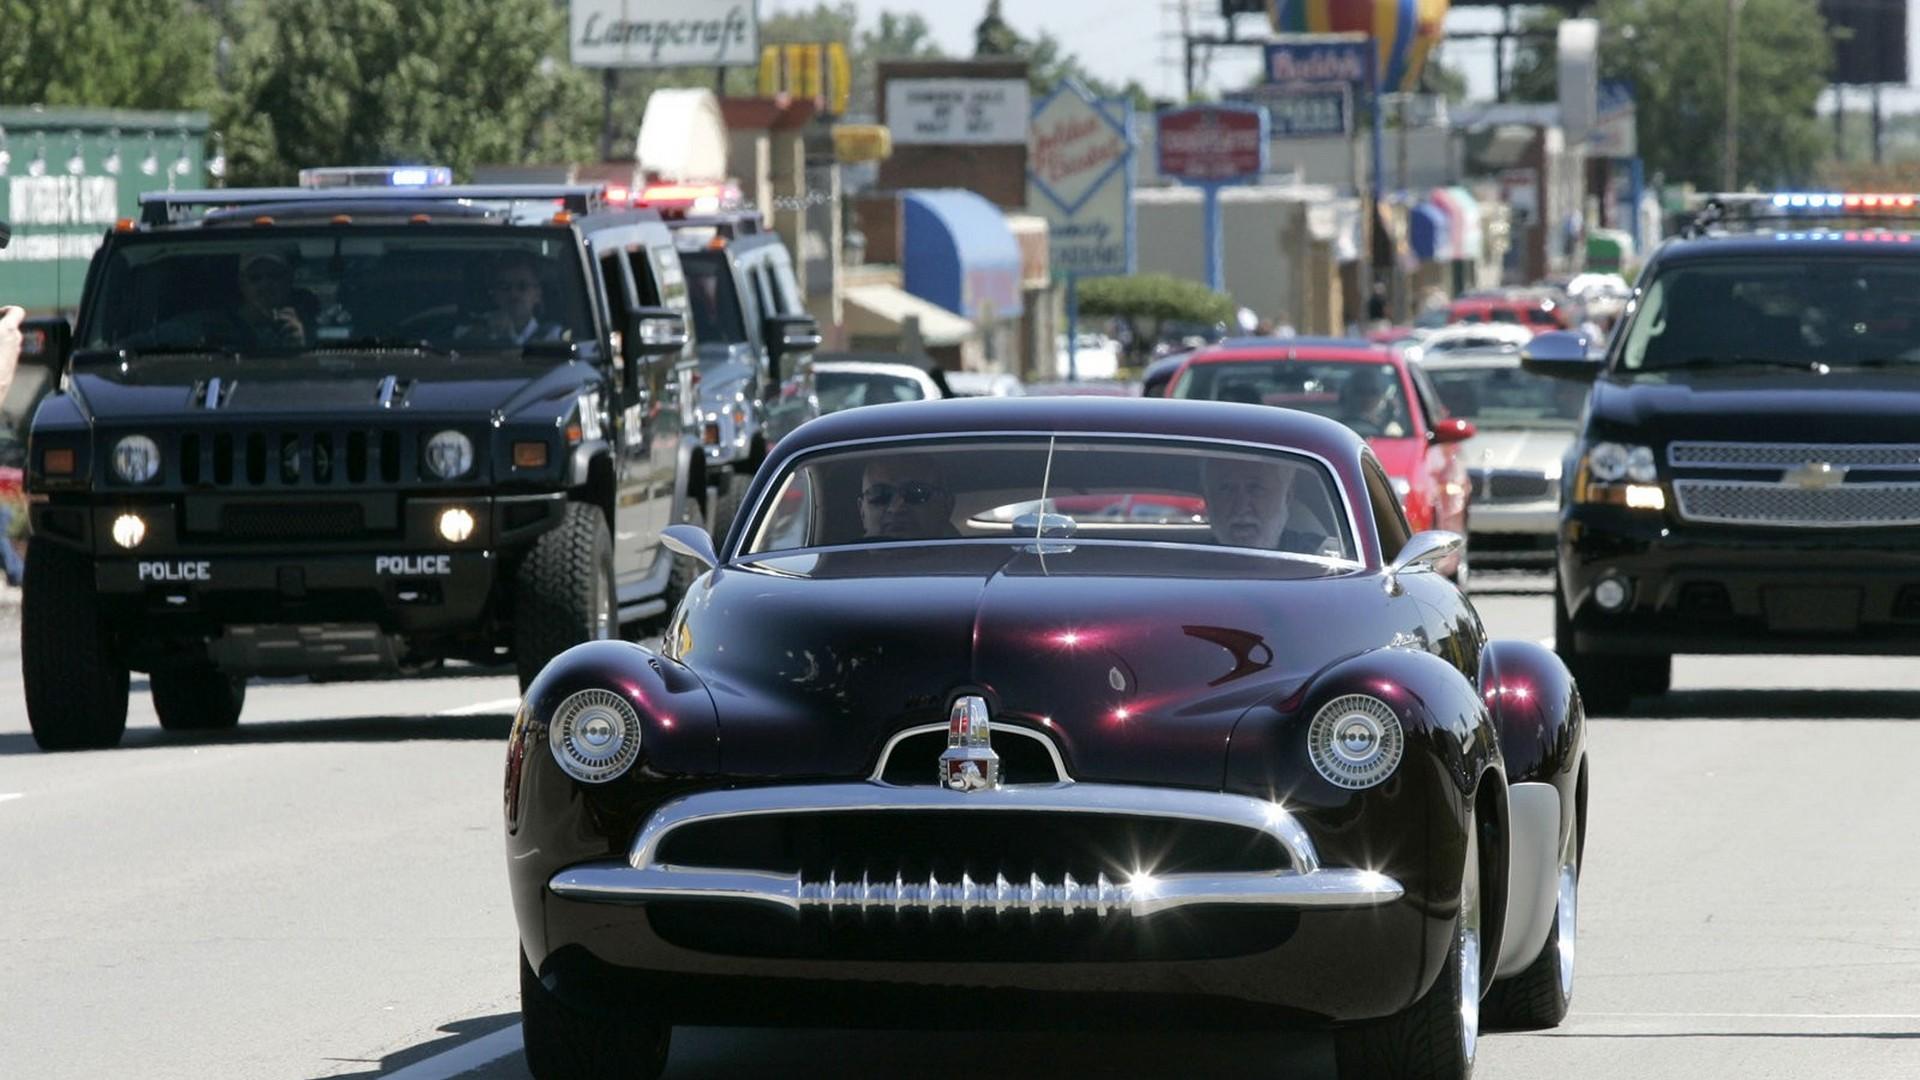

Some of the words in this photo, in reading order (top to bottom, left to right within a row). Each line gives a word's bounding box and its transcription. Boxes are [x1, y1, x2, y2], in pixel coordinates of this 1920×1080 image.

[581, 4, 746, 65] Lampcraft
[138, 561, 211, 580] POLICE
[376, 555, 450, 575] POLICE
